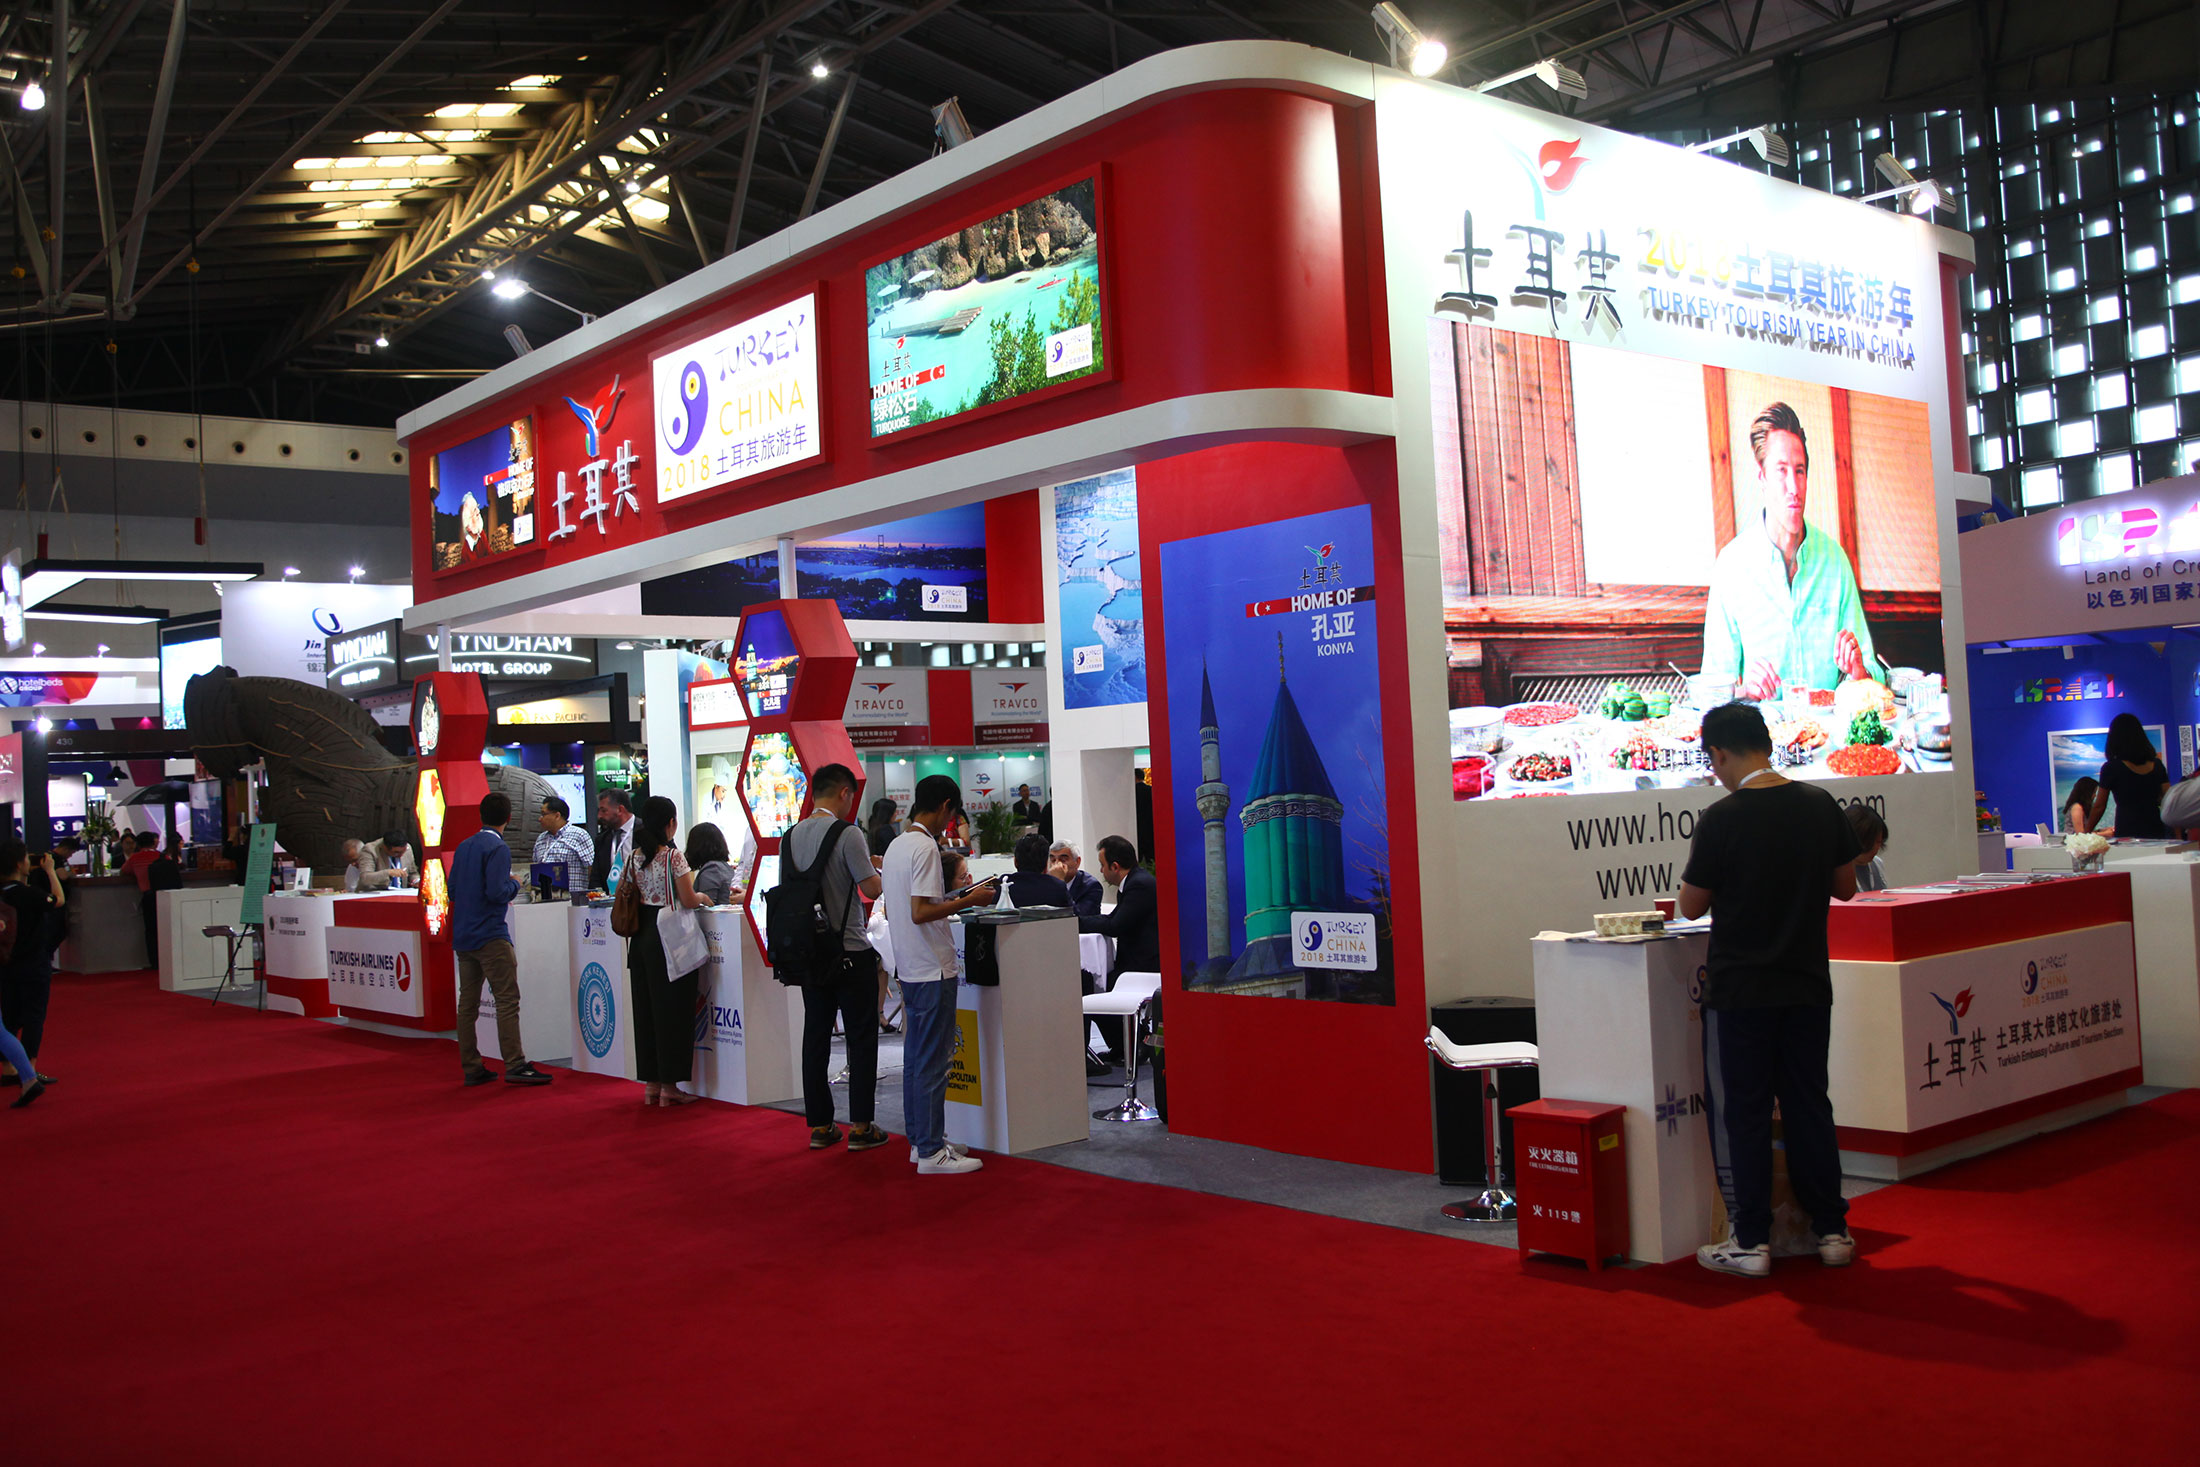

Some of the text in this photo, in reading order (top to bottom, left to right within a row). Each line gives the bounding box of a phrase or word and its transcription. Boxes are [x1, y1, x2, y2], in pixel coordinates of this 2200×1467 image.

[1440, 209, 1624, 331] 土耳其
[1648, 286, 1916, 361] TURKEY TOURISM YEAR IN CHINA
[715, 313, 806, 382] TURKEY
[881, 351, 912, 379] 土耳其
[873, 370, 920, 399] HOME OF
[719, 378, 805, 436] CHINA
[873, 389, 918, 423] 绿松石
[875, 415, 911, 435] TURQUOISE
[663, 423, 808, 493] 2018 土耳其旅游年
[547, 439, 641, 543] 土耳其
[1298, 561, 1343, 590] 土耳其
[2085, 565, 2131, 585] Land
[2143, 561, 2162, 579] of
[1291, 587, 1356, 613] HOME OF
[1311, 610, 1356, 642] 孔亚
[303, 639, 321, 651] Jin
[1317, 641, 1355, 657] KONYA
[451, 661, 553, 675] HOTEL GROUP
[18, 677, 64, 687] hotelbeds
[2014, 673, 2124, 704] ISRAEL
[855, 699, 904, 710] TRAVCO
[993, 698, 1038, 709] TRAVCO
[554, 712, 588, 722] PACIFIC
[56, 737, 73, 746] 430
[1596, 862, 1682, 900] www.
[1325, 920, 1367, 935] TURKEY
[1326, 938, 1367, 952] CHINA
[329, 950, 394, 971] TURKISH AIRLINES
[1300, 952, 1368, 964] 2018 土耳其旅游年
[2040, 974, 2068, 991] CHINA
[1996, 998, 2123, 1051] 土耳其大使馆文化旅游处
[596, 1021, 615, 1054] COUNCIL
[1997, 1027, 2124, 1068] Turkish Embassy Culture and Tourism Section
[1919, 1026, 1988, 1091] 土耳其
[947, 1073, 977, 1084] OPOLITAN
[1690, 1092, 1706, 1115] IN
[1528, 1145, 1579, 1166] 灭火器箱
[1532, 1204, 1543, 1217] 火
[1548, 1208, 1569, 1221] 119
